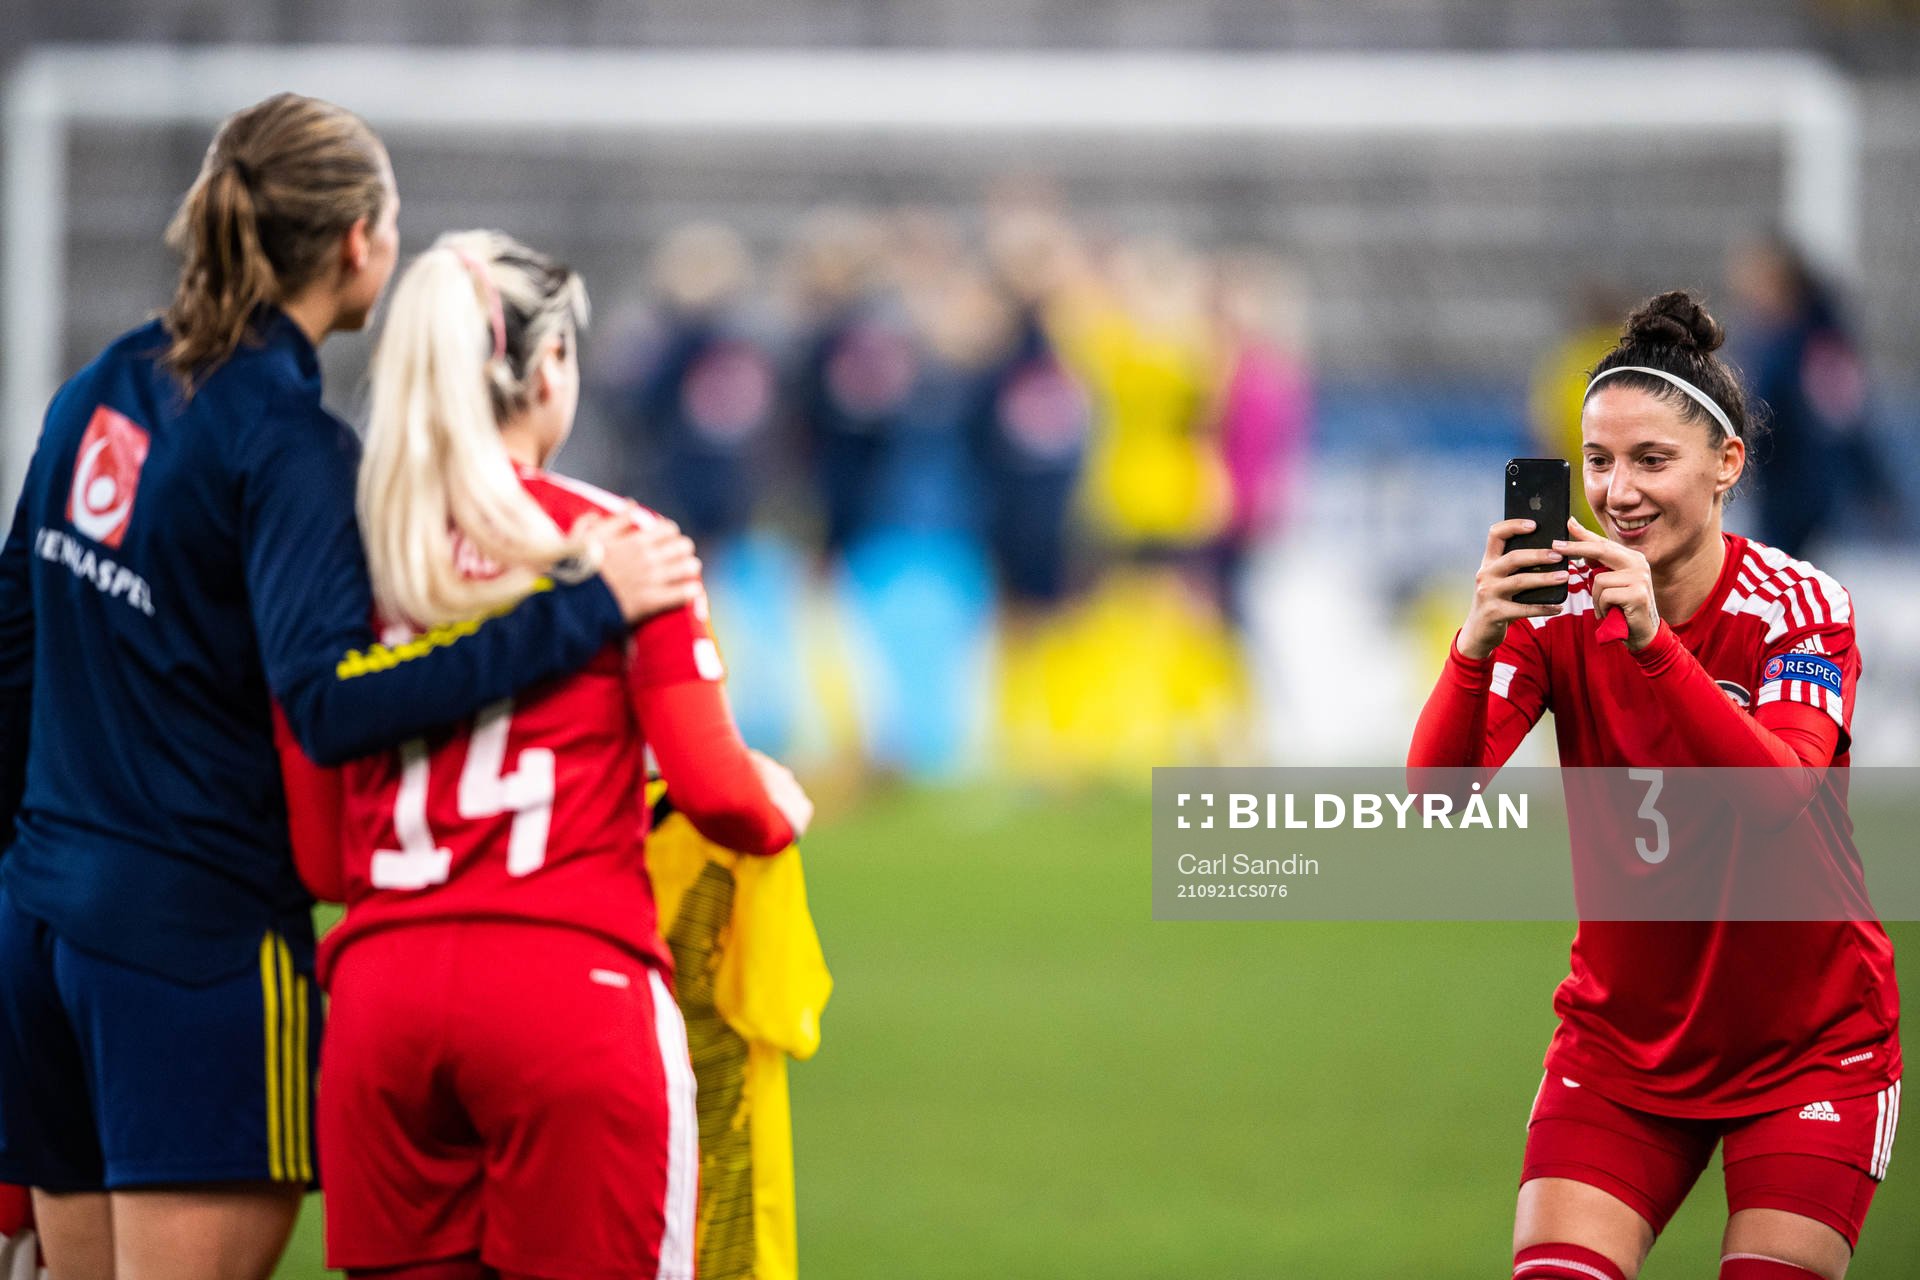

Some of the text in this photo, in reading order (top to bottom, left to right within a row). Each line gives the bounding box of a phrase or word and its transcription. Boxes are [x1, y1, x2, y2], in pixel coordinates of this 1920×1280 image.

[1785, 660, 1842, 688] RESPECT
[370, 698, 556, 891] 14
[1628, 767, 1670, 864] 3
[1799, 1110, 1840, 1122] adidas
